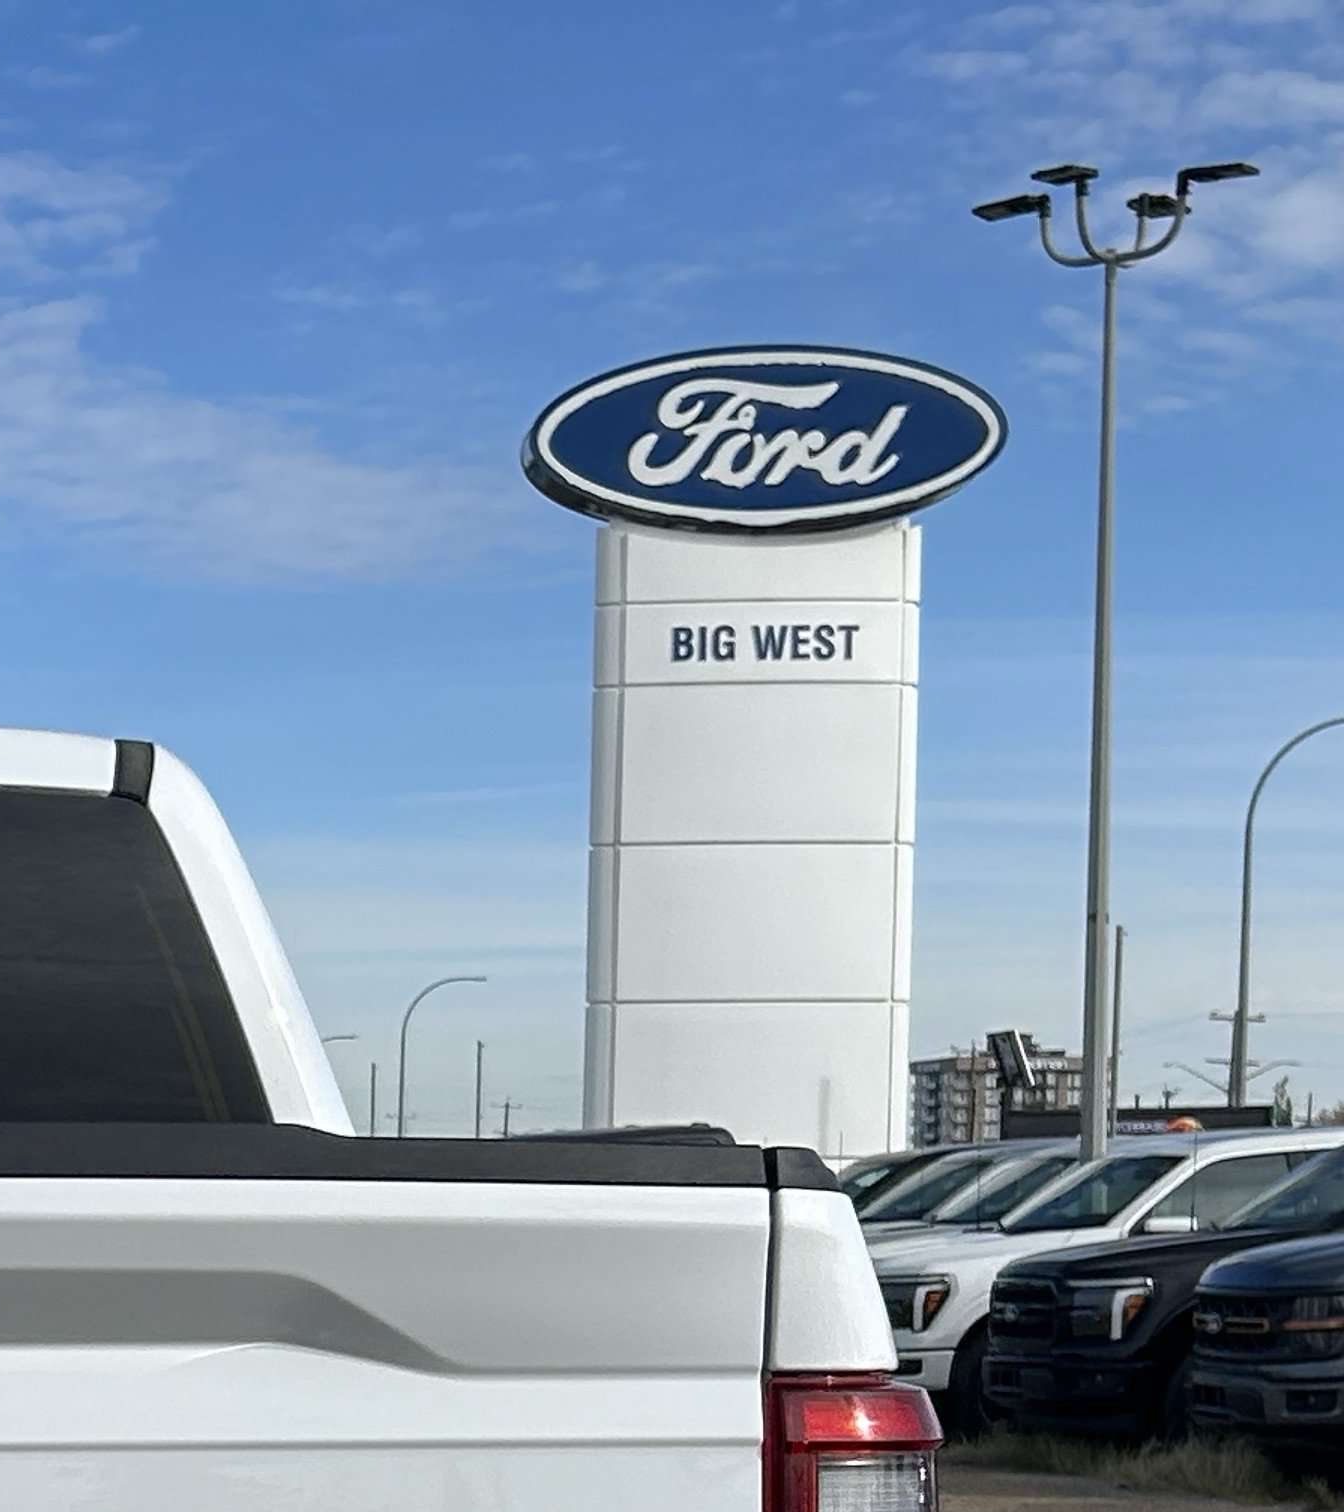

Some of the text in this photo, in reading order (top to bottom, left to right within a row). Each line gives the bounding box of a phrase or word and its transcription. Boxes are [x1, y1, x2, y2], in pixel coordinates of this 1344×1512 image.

[627, 378, 909, 489] Ford
[671, 624, 861, 663] BIG WEST
